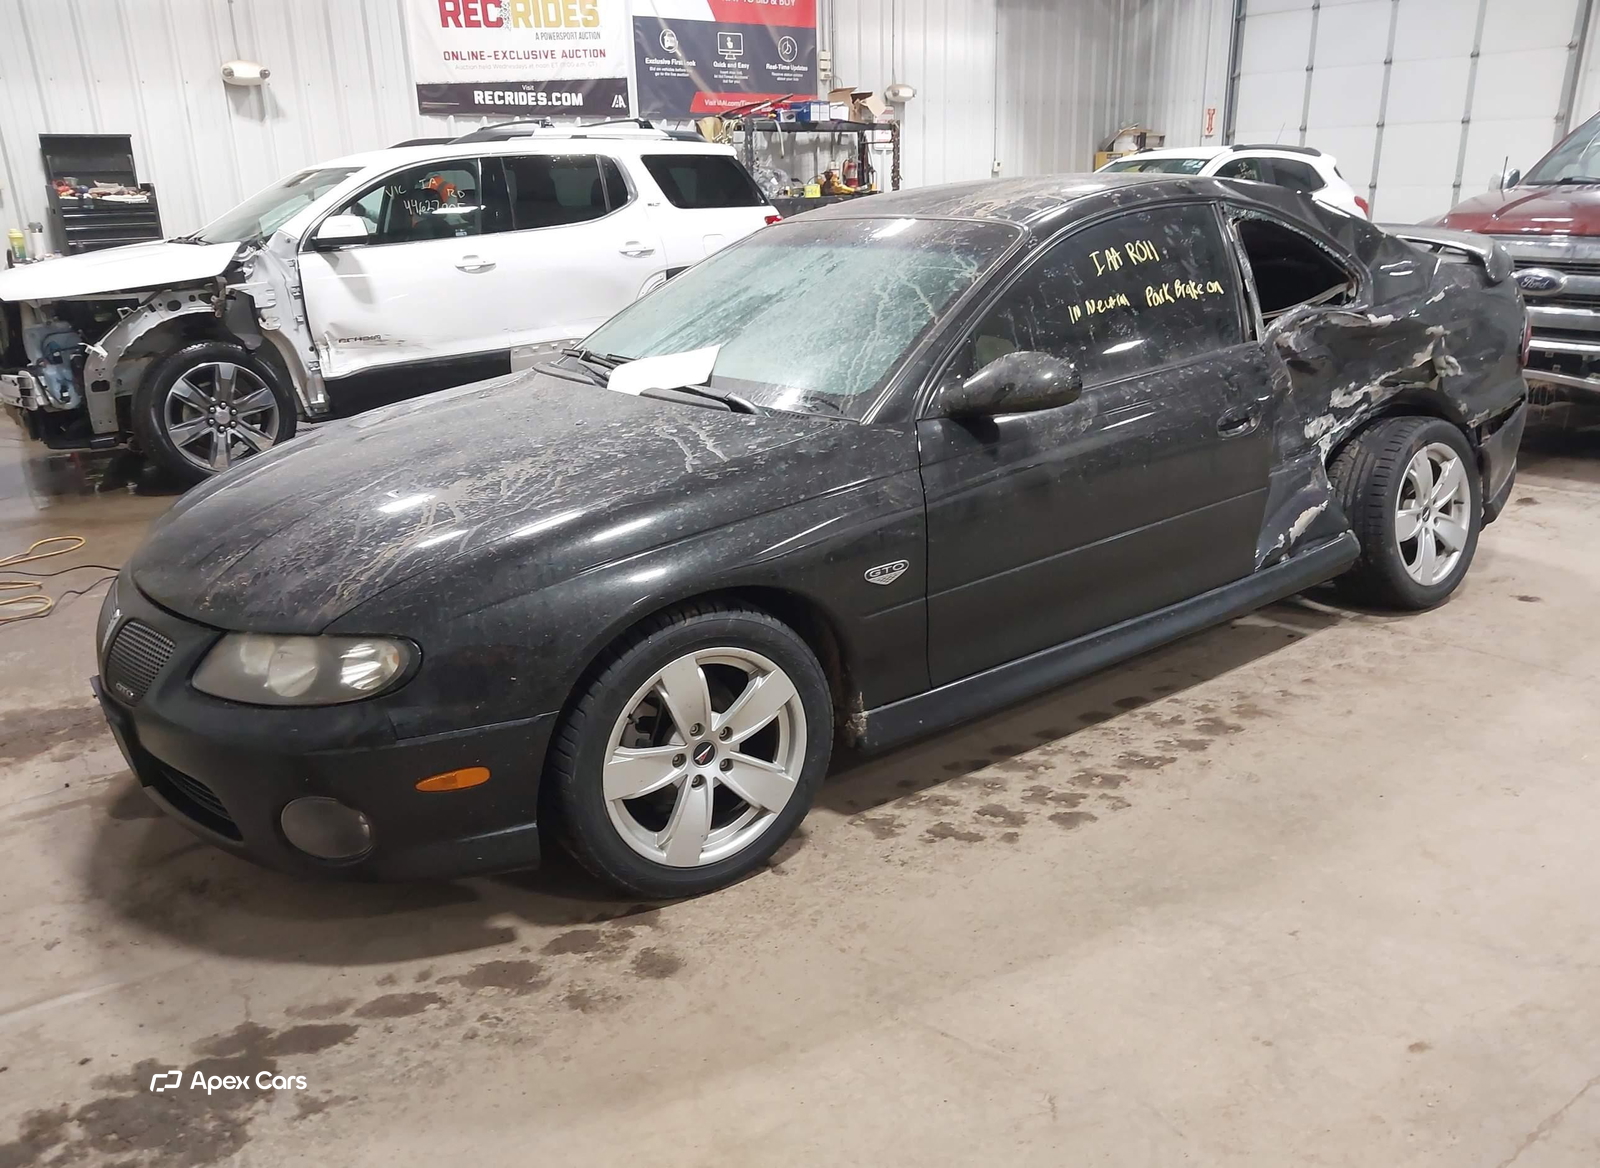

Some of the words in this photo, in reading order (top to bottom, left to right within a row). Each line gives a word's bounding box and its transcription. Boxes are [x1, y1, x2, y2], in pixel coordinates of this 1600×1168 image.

[439, 0, 504, 28] REC
[511, 0, 600, 28] RIDES
[541, 32, 577, 40] POWERSPORT
[578, 31, 601, 40] AUCTION
[443, 49, 557, 61] ONLINE-EXCLUSIVE
[561, 49, 606, 59] AUCTION
[738, 61, 750, 70] Easy
[473, 90, 584, 107] RECRIDES.COM
[1520, 275, 1550, 289] Ford
[869, 562, 905, 578] GTO
